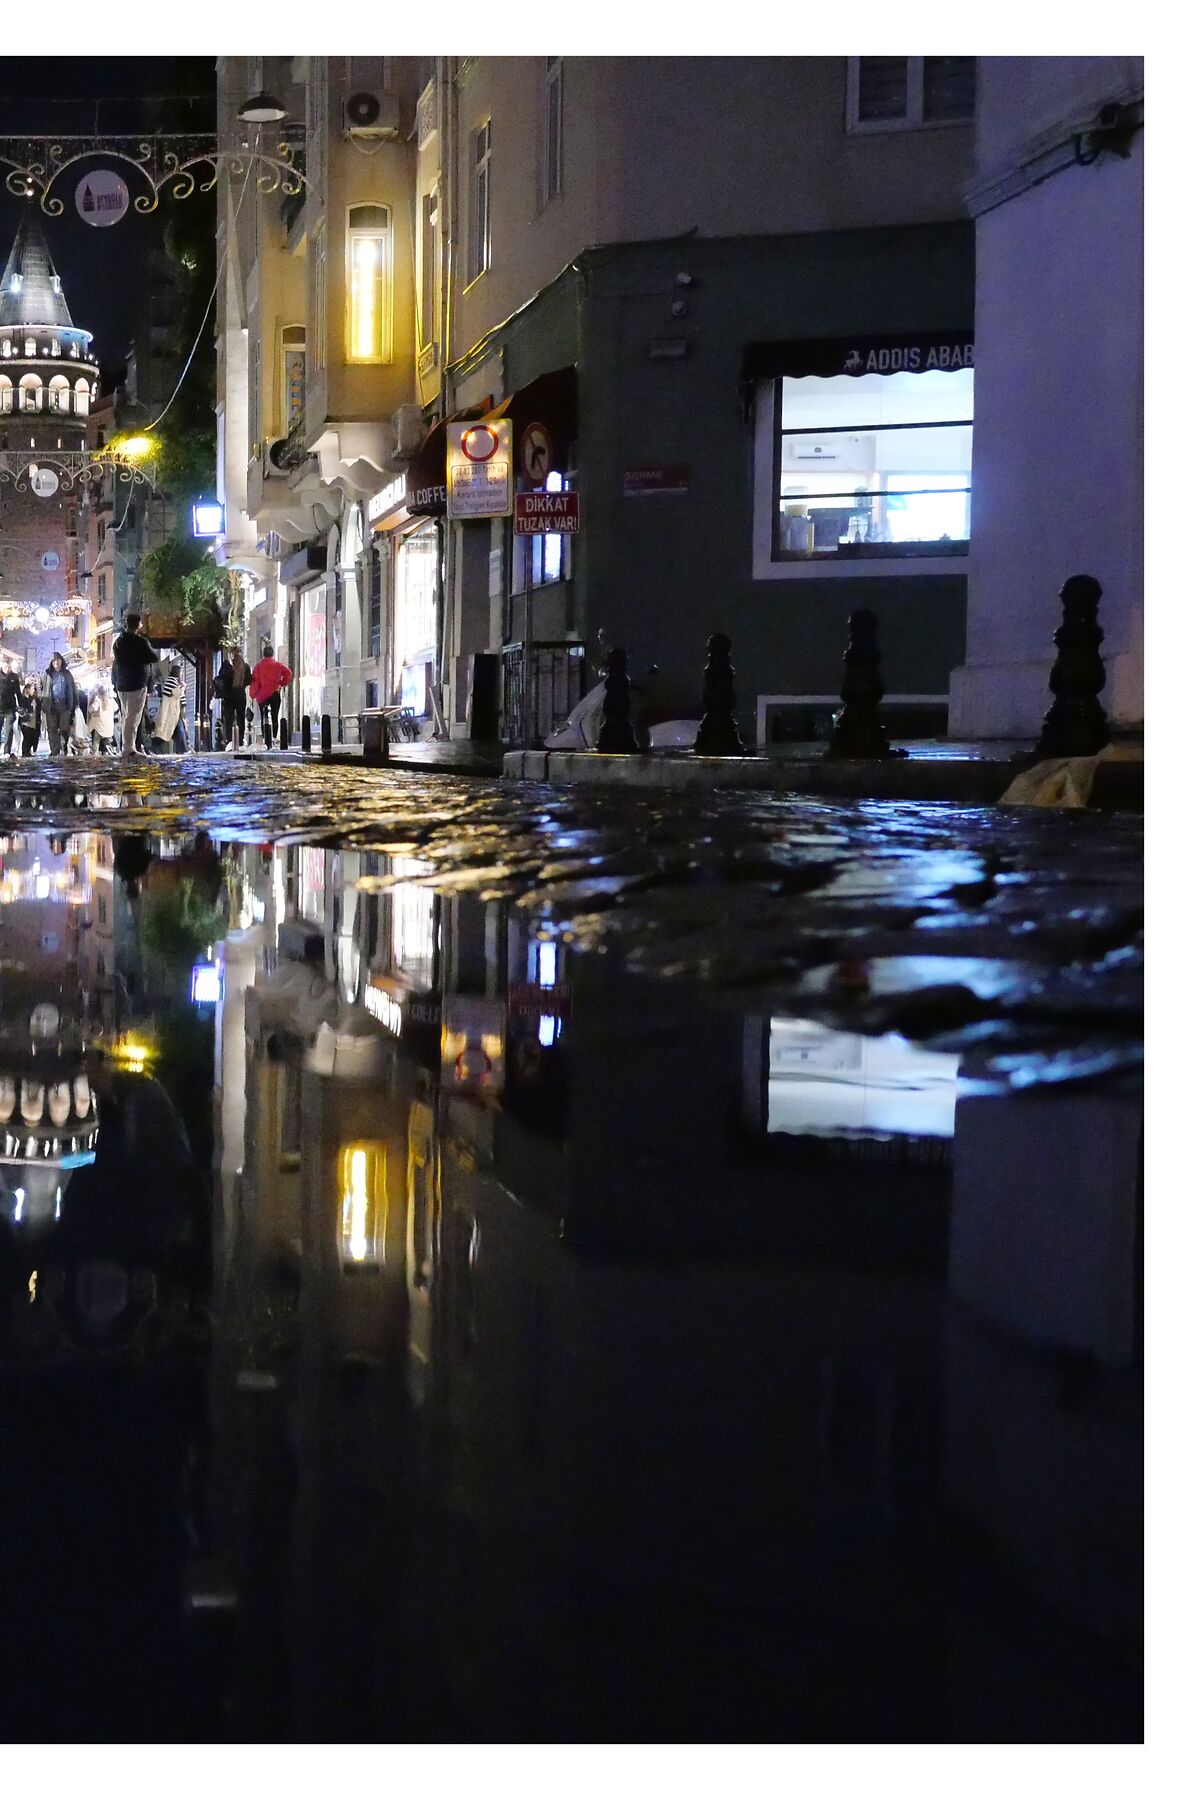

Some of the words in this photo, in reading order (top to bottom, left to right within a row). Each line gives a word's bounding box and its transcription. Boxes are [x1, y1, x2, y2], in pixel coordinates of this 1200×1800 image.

[866, 347, 921, 370] ADDIS
[926, 344, 975, 367] ABAB
[525, 496, 569, 513] DİKKAT
[518, 515, 550, 532] TUZAK
[553, 515, 578, 532] VAR!
